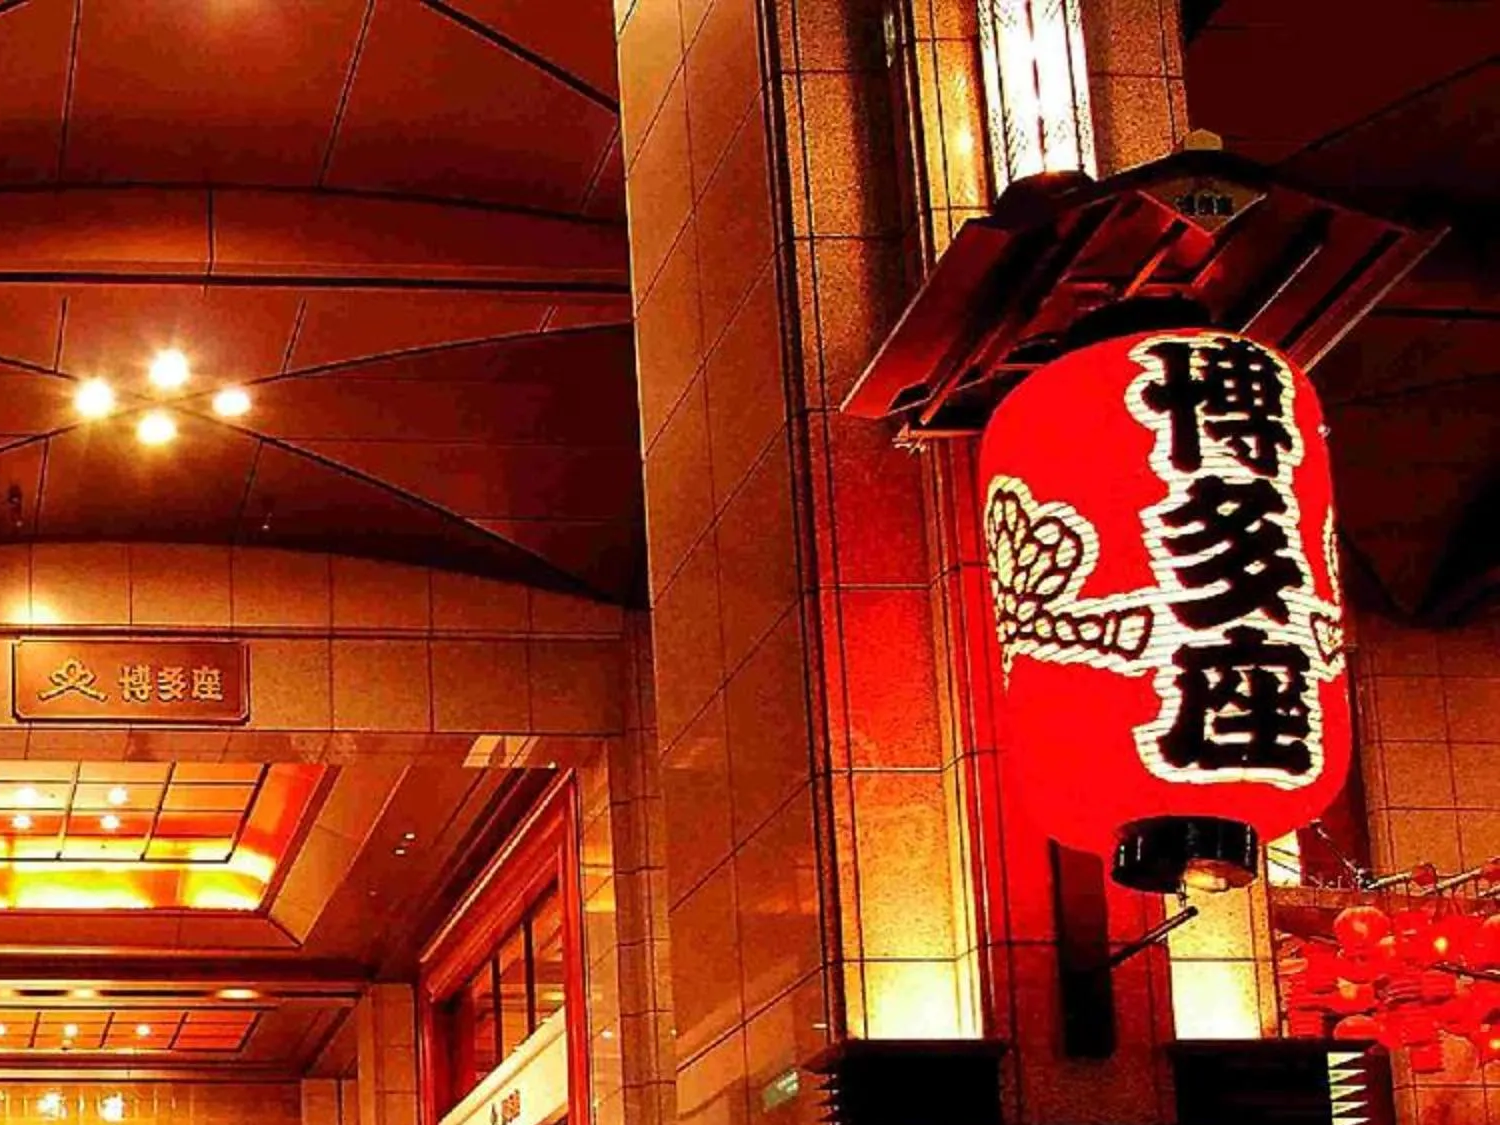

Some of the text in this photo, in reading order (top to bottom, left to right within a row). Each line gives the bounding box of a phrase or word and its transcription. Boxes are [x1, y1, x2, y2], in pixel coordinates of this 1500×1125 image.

[1141, 337, 1312, 775] 博多座
[118, 664, 224, 702] 博多座
